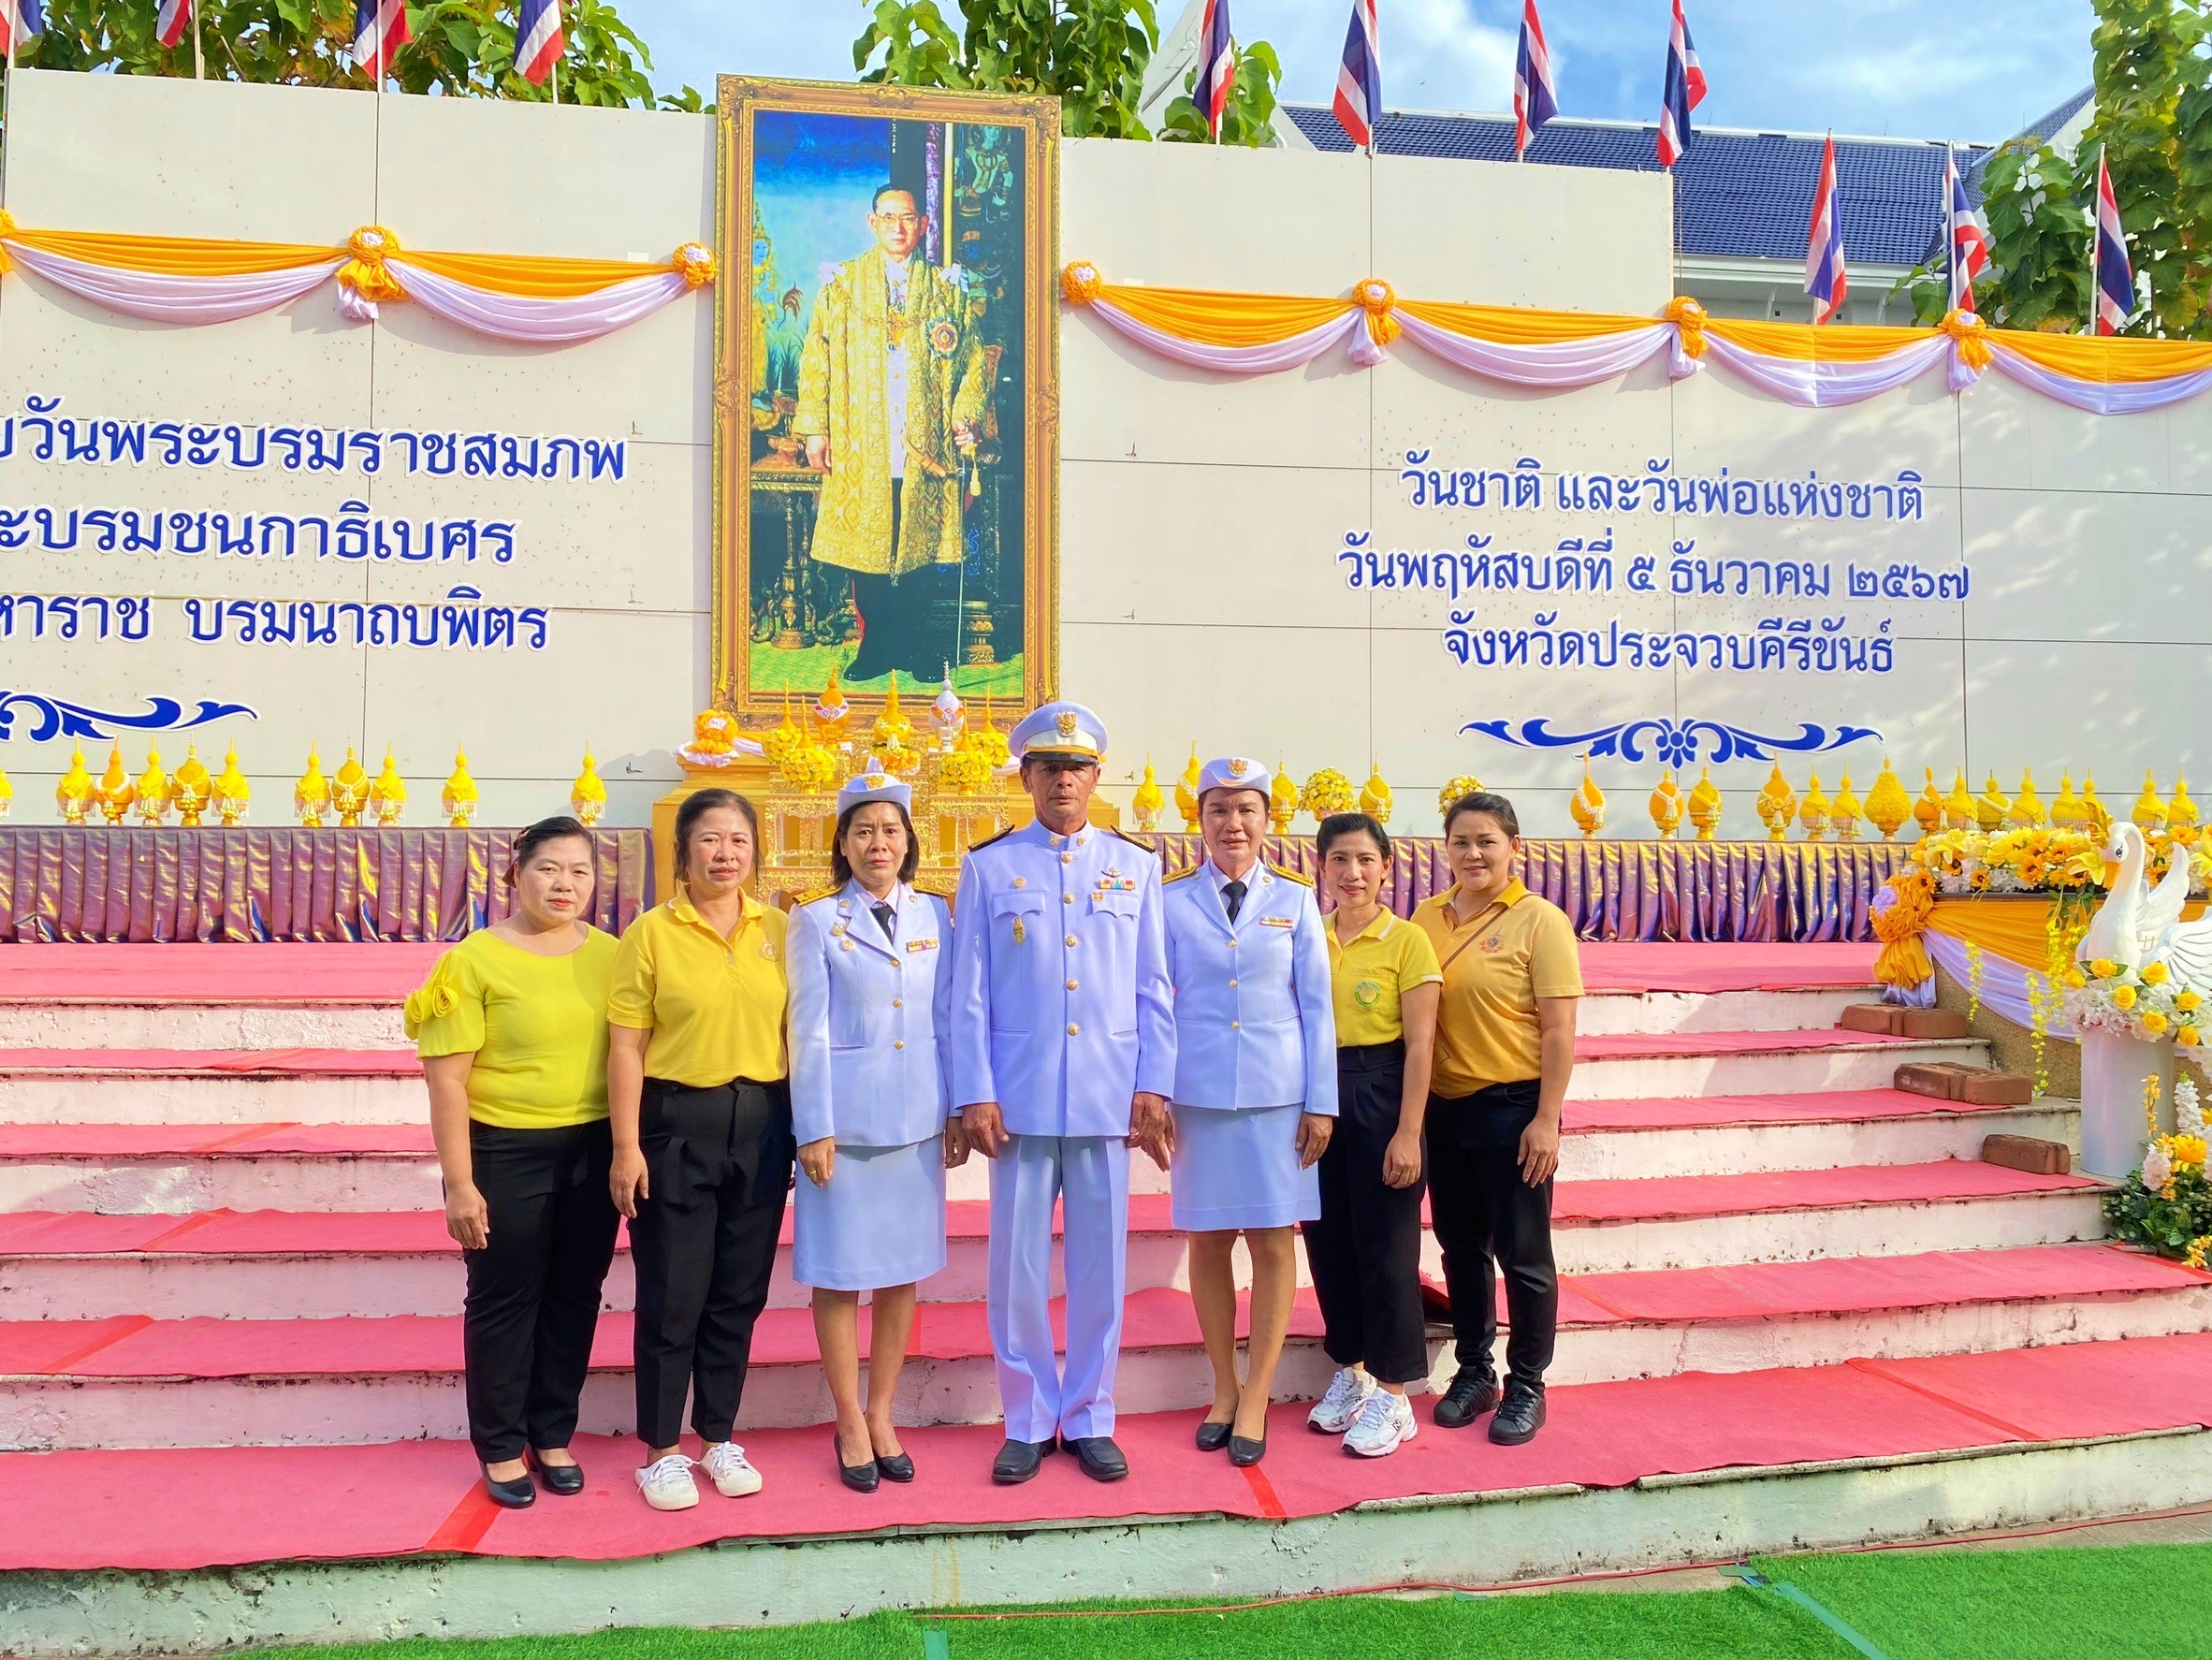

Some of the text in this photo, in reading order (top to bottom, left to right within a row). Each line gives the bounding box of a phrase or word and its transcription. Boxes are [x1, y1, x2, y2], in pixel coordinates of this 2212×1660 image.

[1403, 450, 1923, 520] วันชาติ และวันพ่อแห่งชาติ
[0, 500, 517, 563] ะบรมชนกาธิเบศร
[1338, 527, 1970, 600] วันพฤหัสบดีที่ ๕ ธันวาคม ๒๕๖๗
[185, 585, 549, 649] บรมนาถบพิตร
[1444, 610, 1894, 673] จังหวัดประจวบคีรีขันธ์
